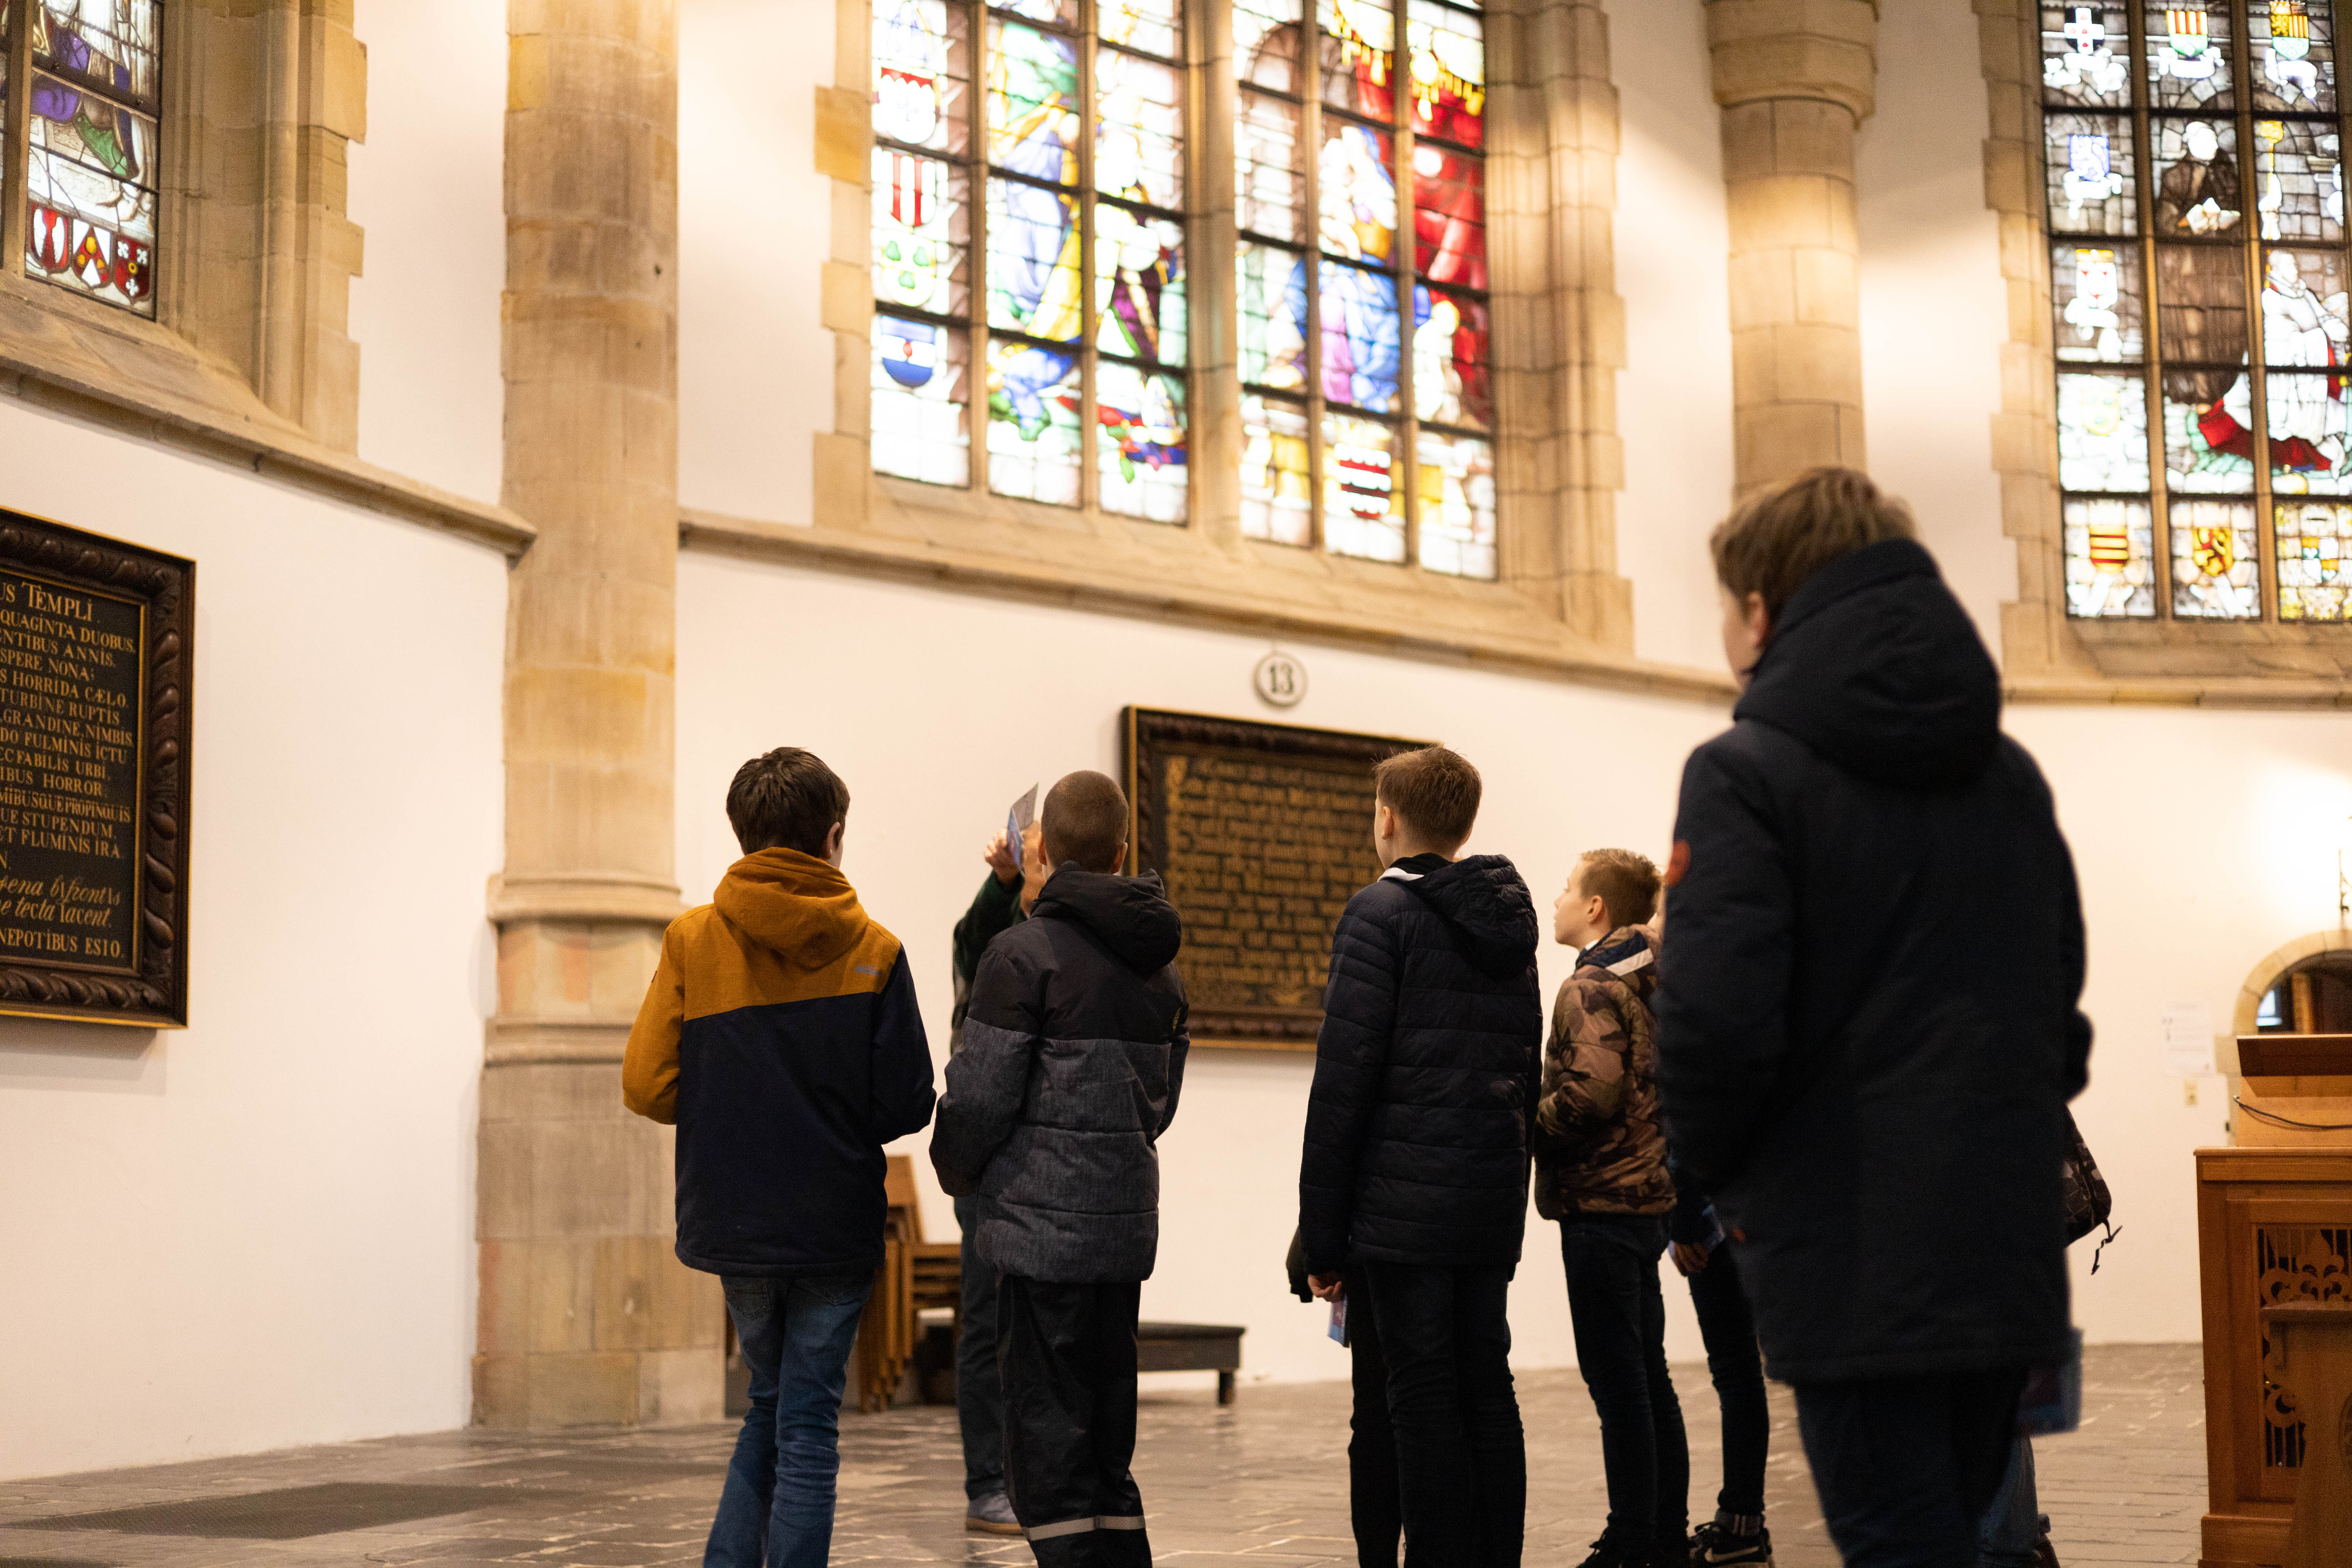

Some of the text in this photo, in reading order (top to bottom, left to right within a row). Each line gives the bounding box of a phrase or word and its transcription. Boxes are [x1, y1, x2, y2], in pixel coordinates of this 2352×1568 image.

[0, 628, 58, 655] NTIBUS
[13, 671, 79, 698] HORRIDA
[1270, 663, 1293, 695] 13
[0, 687, 120, 726] TURBINE RUPTIS
[25, 731, 92, 758] FULMINIS
[96, 741, 127, 764] ICTU
[43, 773, 102, 797] HORROR
[21, 829, 91, 854] FLUMINIS
